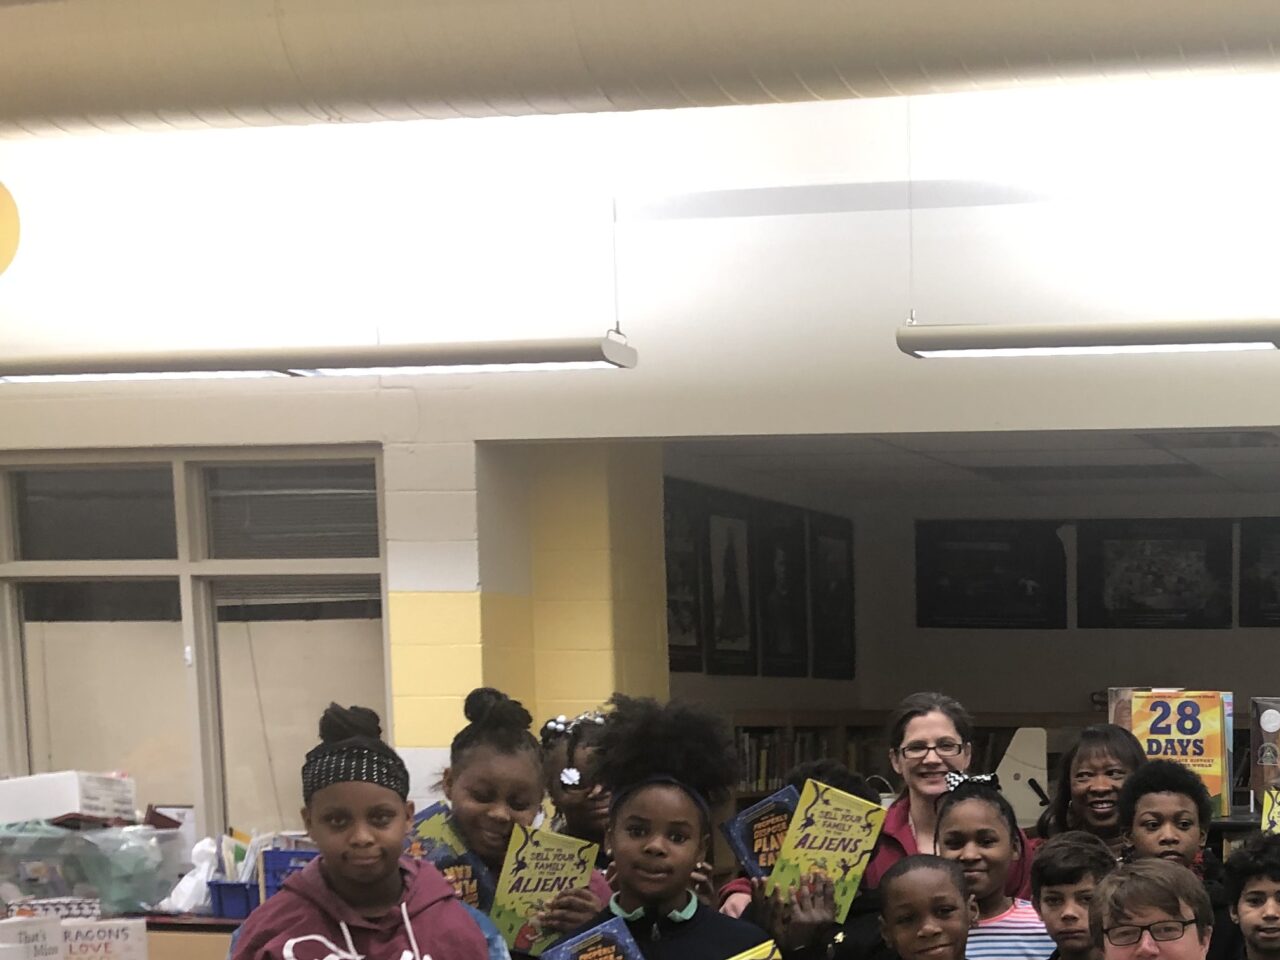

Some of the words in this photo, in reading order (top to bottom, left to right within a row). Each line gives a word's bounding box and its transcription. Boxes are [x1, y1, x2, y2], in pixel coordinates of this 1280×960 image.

[1149, 700, 1201, 736] 28
[1146, 739, 1204, 756] DAYS
[818, 810, 838, 820] SELL
[841, 813, 863, 823] YOUR
[822, 820, 853, 831] FAMILY
[754, 832, 785, 853] PLAN
[793, 832, 863, 853] ALIENS
[508, 876, 578, 895] ALIENS
[63, 928, 130, 942] RAGONS
[69, 942, 113, 955] LOVE
